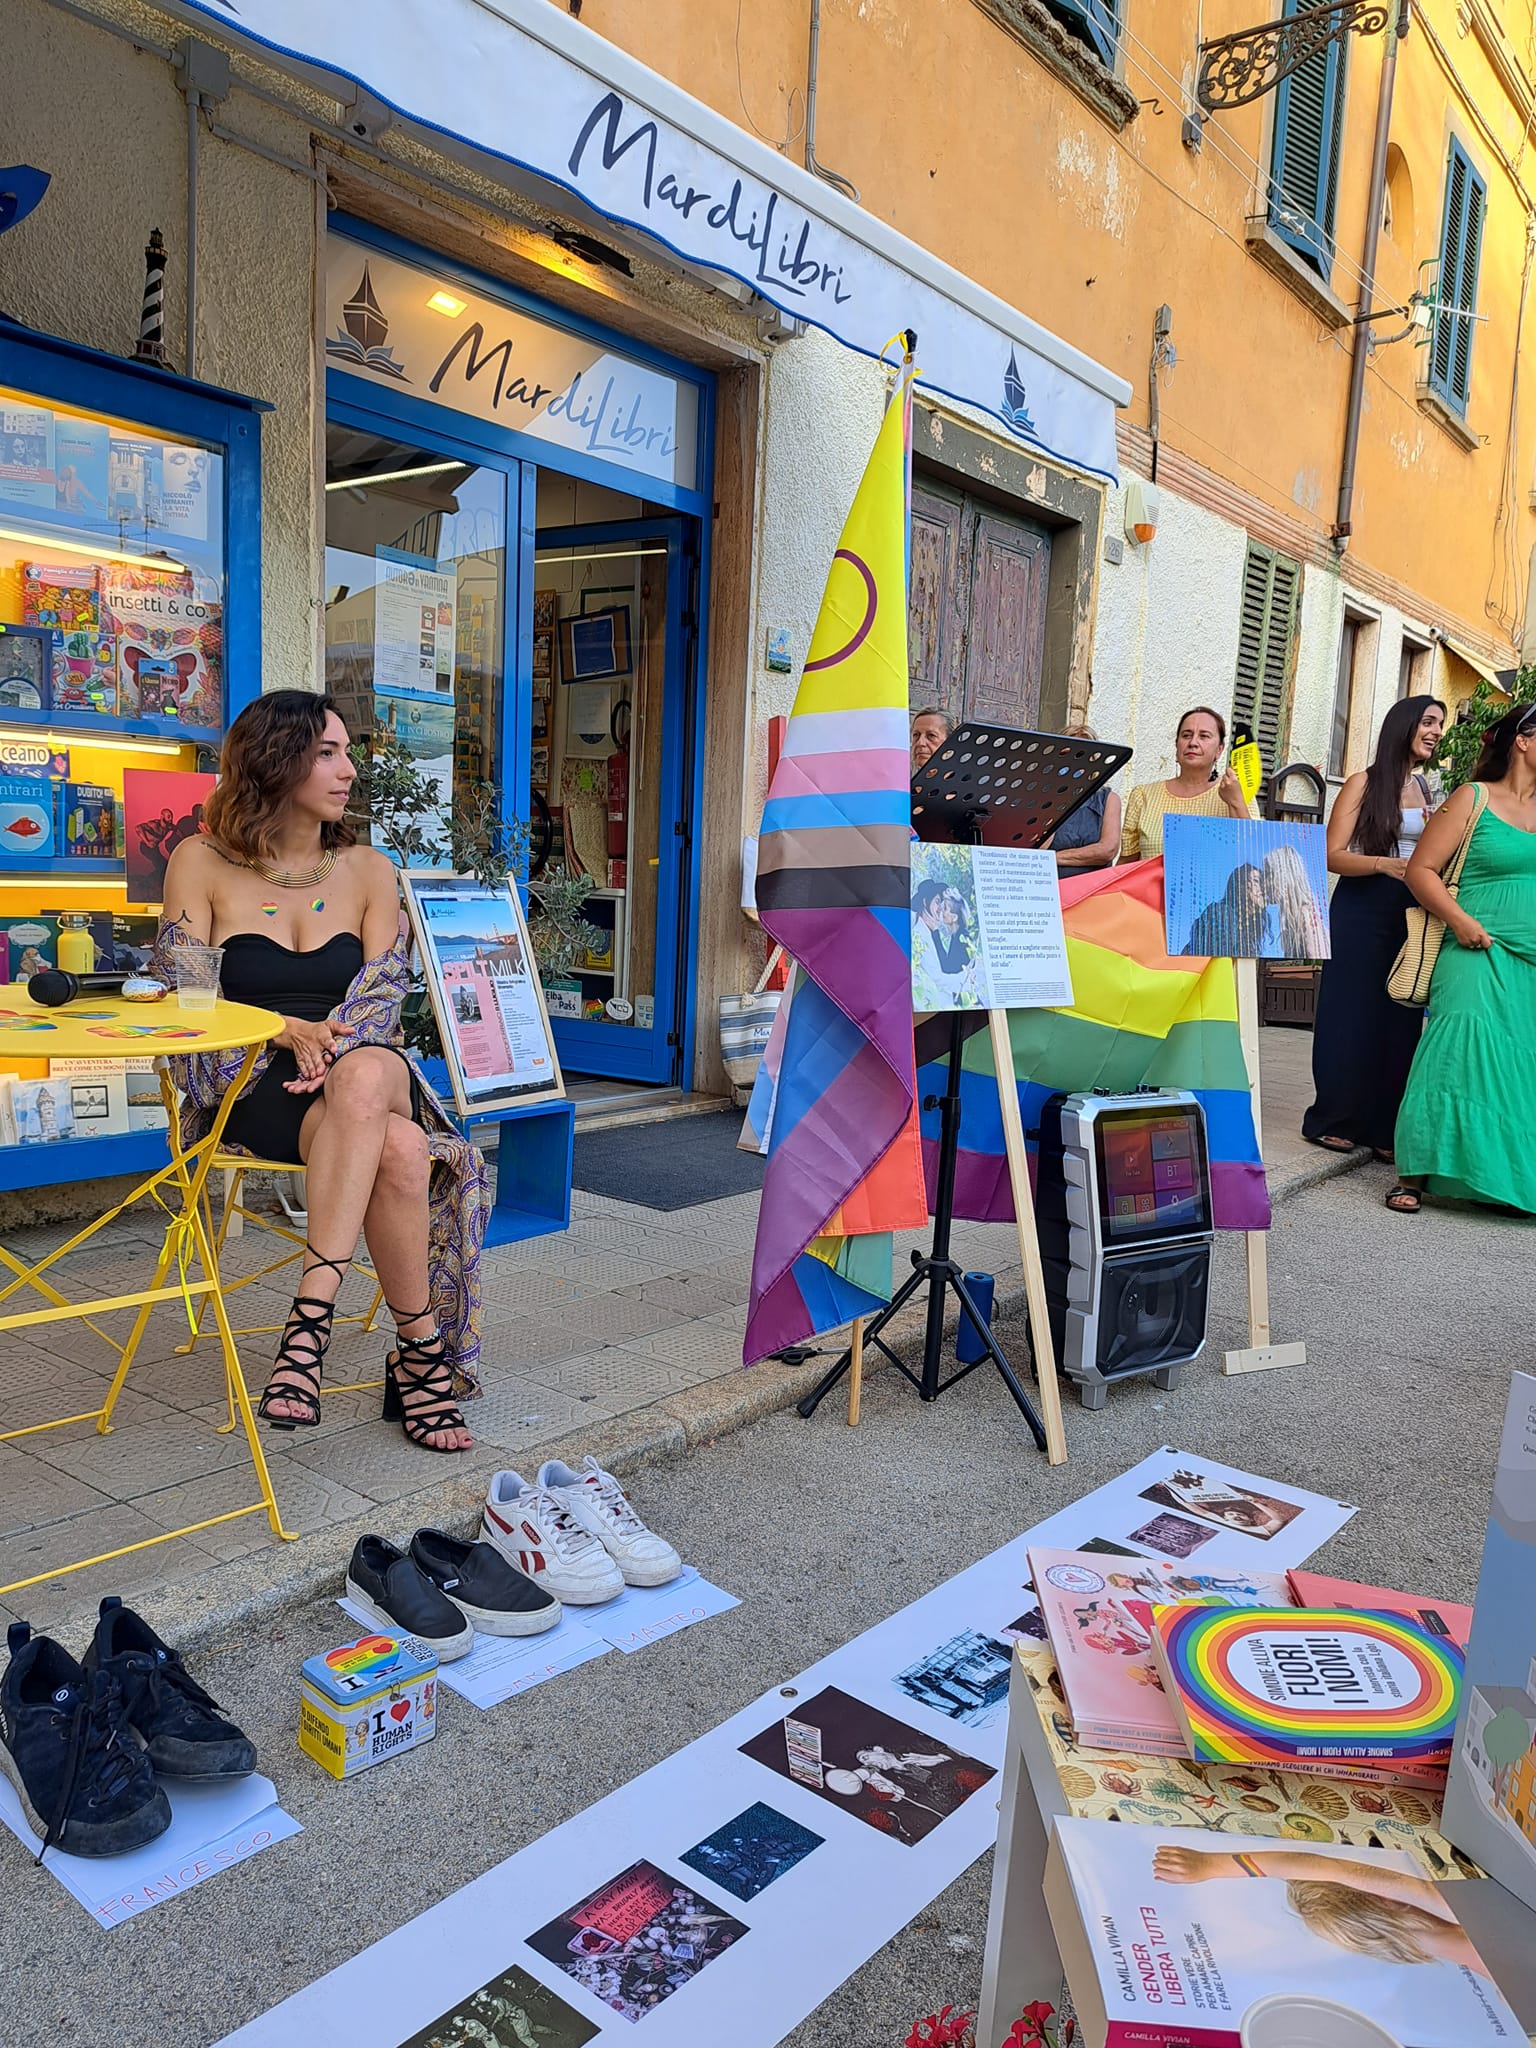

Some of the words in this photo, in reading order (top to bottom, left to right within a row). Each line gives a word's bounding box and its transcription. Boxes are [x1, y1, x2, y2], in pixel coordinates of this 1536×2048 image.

[568, 91, 852, 304] MardiLibri
[429, 321, 679, 456] MardiLibri
[109, 592, 163, 613] insetti
[167, 601, 179, 614] &
[184, 604, 209, 619] co.
[489, 959, 527, 977] MILK
[614, 1607, 706, 1649] MATTEO
[1269, 1644, 1326, 1696] FUORI
[1304, 1637, 1364, 1693] NOMI!
[1258, 1668, 1287, 1701] SIMONE
[372, 1710, 386, 1736] I
[372, 1720, 413, 1748] HUMAN
[372, 1730, 413, 1757] RIGHTS
[593, 1890, 617, 1911] GAY
[616, 1872, 640, 1894] MAN
[1100, 1914, 1122, 1949] VIVIAN
[1111, 1950, 1137, 2002] CAMILLA
[1131, 1942, 1164, 2005] GENDER
[1156, 1951, 1187, 2006] LIBERA
[1181, 1956, 1195, 1978] VERE
[1188, 1978, 1206, 2009] STORIE
[1205, 1991, 1219, 2010] PER
[1213, 1980, 1228, 2004] FARE
[1124, 2031, 1161, 2041] CAMILLA
[1162, 2034, 1190, 2044] VIVIAN
